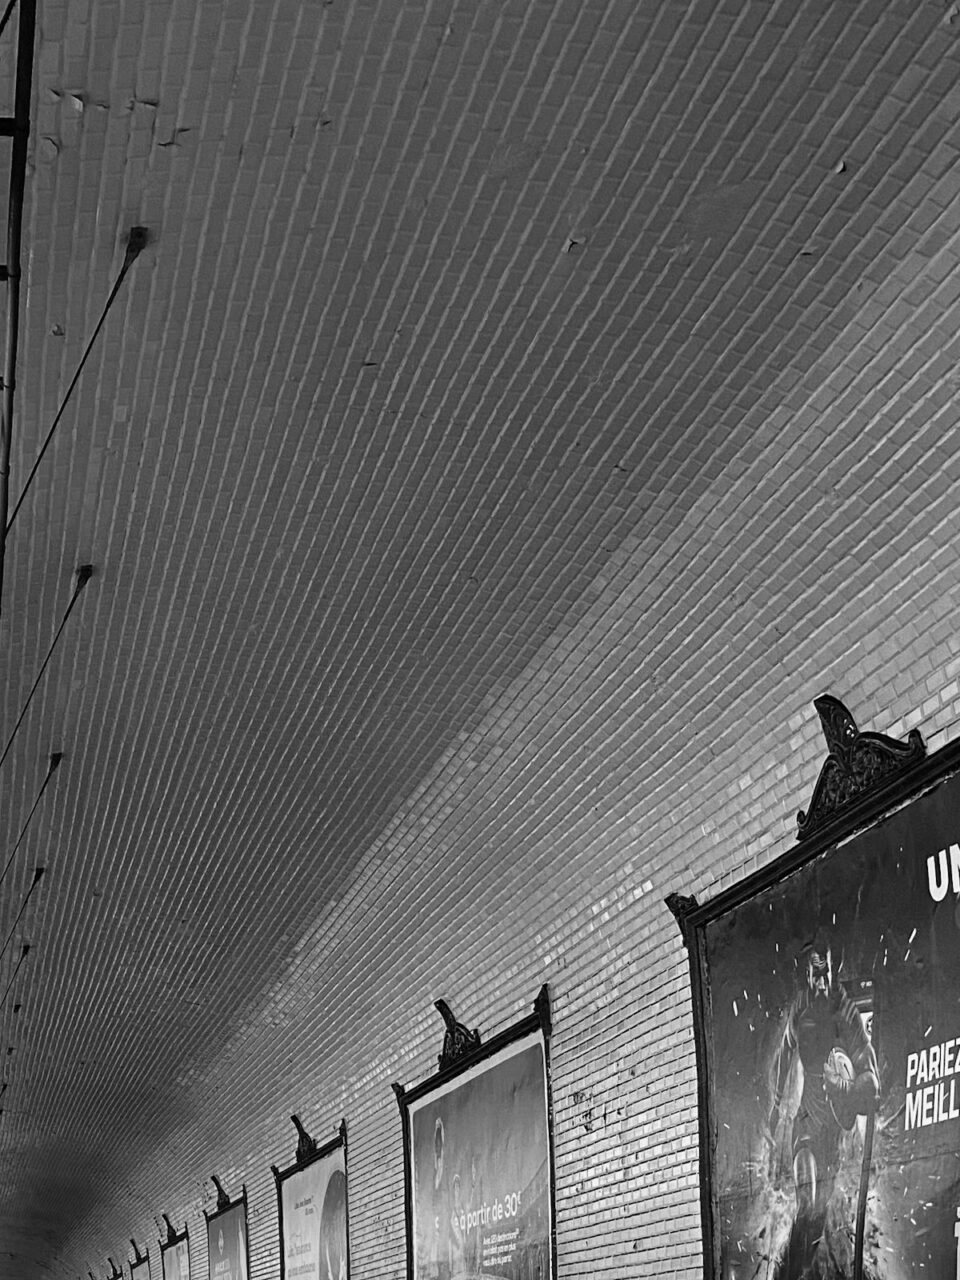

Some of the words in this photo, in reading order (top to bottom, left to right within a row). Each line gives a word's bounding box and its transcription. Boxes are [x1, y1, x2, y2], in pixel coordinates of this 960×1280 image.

[460, 1209, 466, 1230] à
[467, 1202, 491, 1235] partir
[492, 1198, 503, 1221] de
